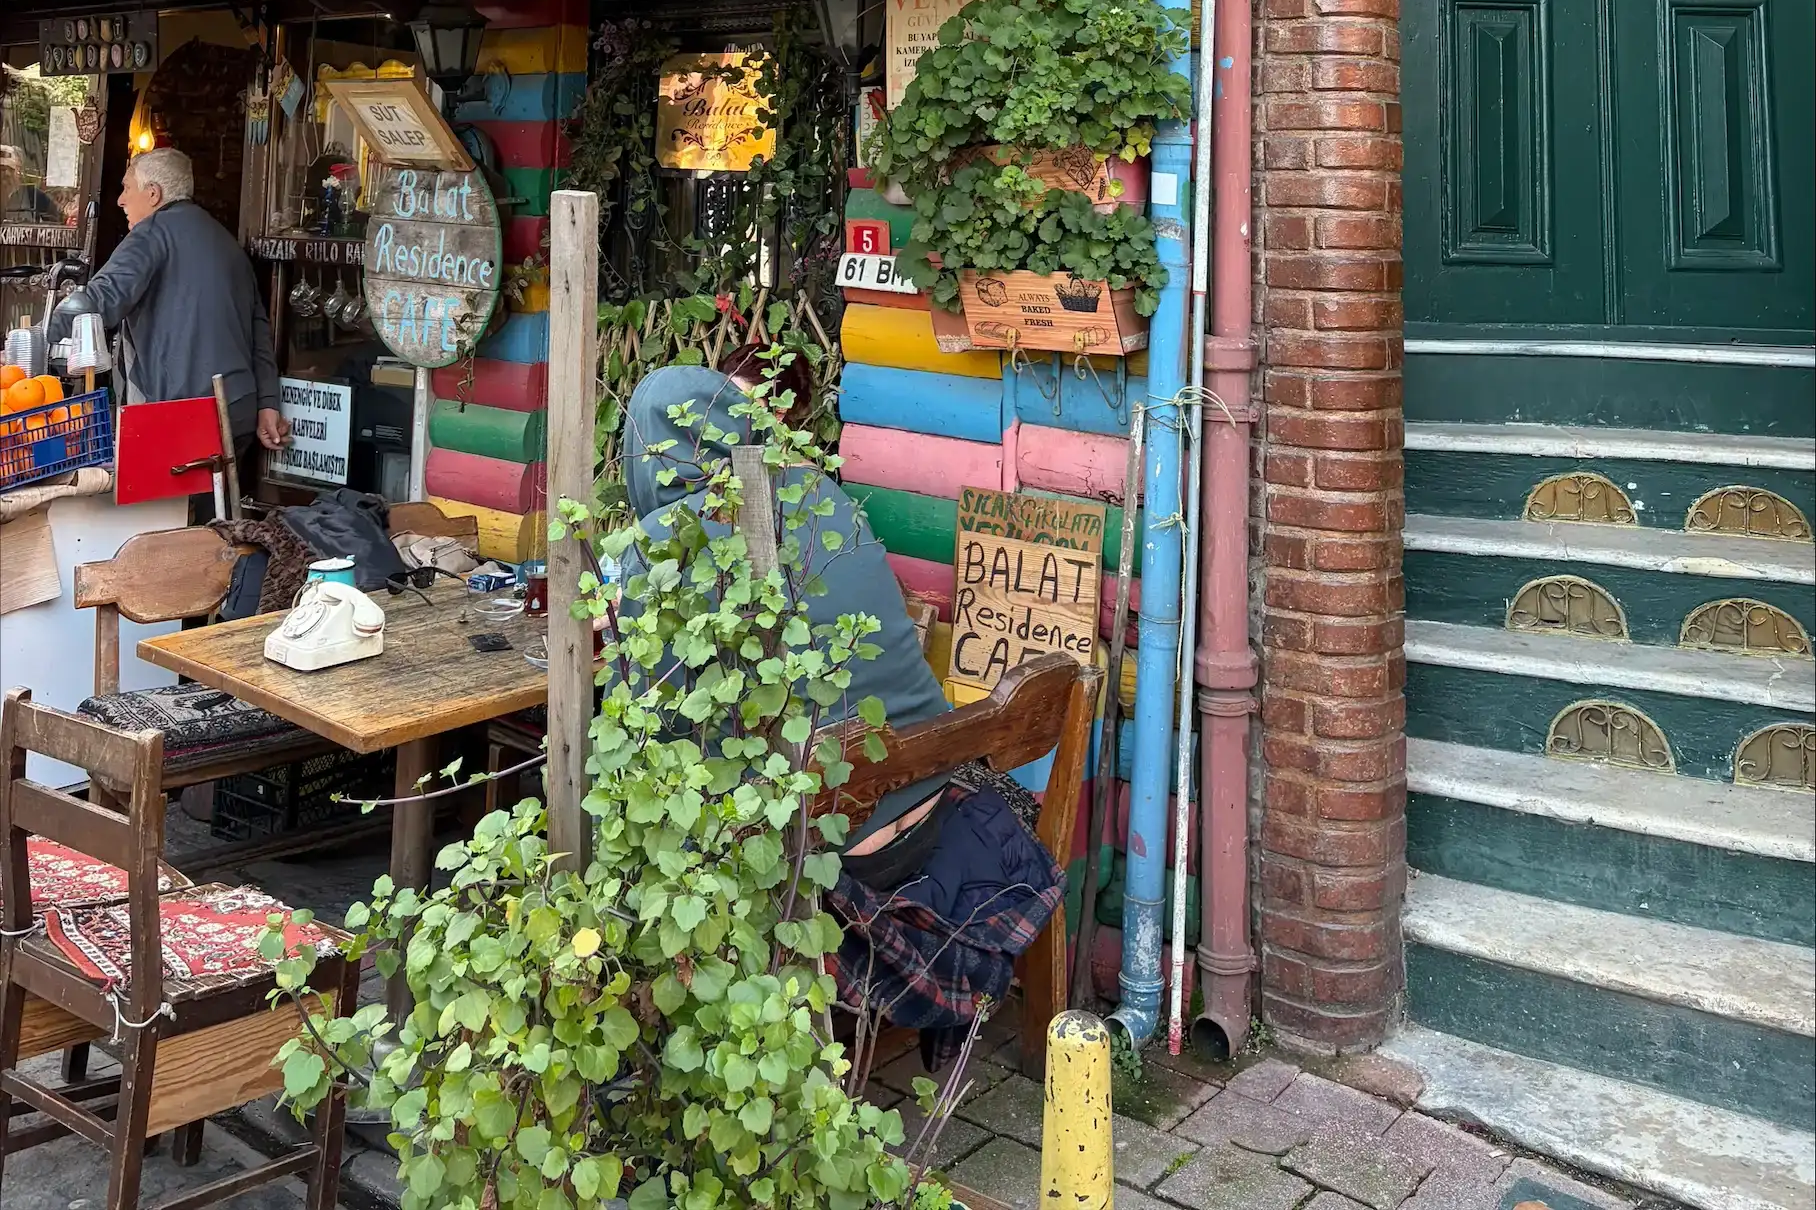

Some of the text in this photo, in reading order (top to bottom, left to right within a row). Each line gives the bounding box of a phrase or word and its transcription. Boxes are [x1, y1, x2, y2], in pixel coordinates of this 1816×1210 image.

[369, 102, 402, 122] SÜT
[378, 130, 425, 147] SALEP
[392, 169, 474, 220] Balat
[305, 242, 338, 263] RULO
[862, 230, 873, 252] 5
[375, 223, 494, 288] Residence
[844, 257, 867, 282] 61
[1018, 293, 1050, 303] ALWAYS
[382, 290, 461, 352] CAFE
[1021, 305, 1051, 315] BAKED
[1024, 318, 1053, 327] FRESH
[281, 383, 342, 412] MENENGİÇ VE DİBEK
[964, 540, 1095, 603] BALAT
[955, 587, 1092, 654] Residence
